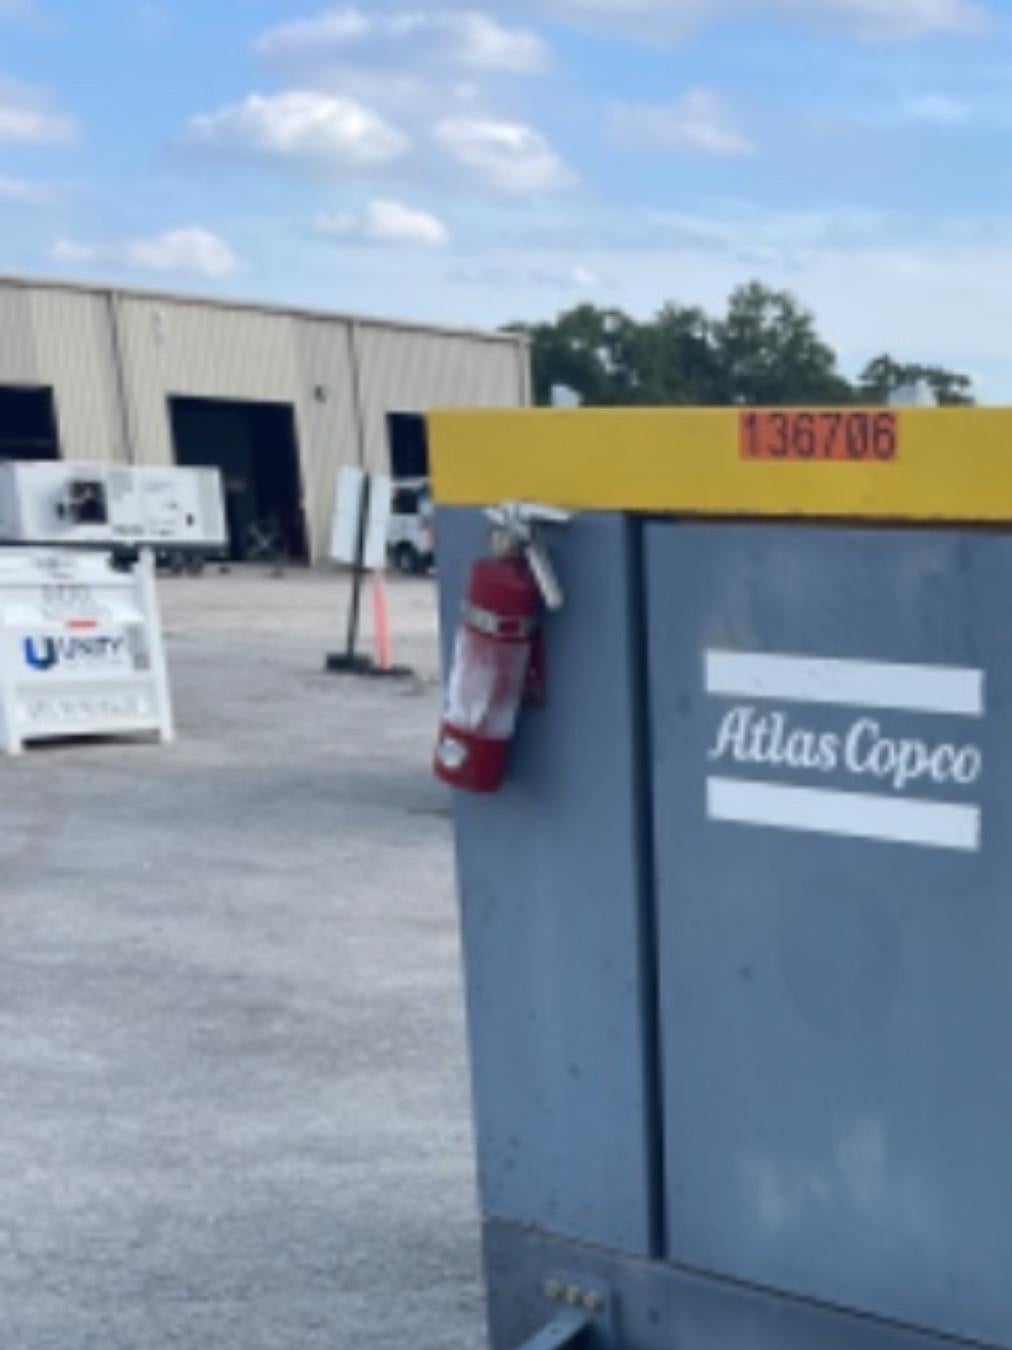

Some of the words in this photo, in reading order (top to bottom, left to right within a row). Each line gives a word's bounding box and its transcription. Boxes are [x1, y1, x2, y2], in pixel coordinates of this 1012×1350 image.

[741, 409, 896, 461] 136706
[706, 704, 842, 774] Atlas
[843, 716, 984, 790] Copco
